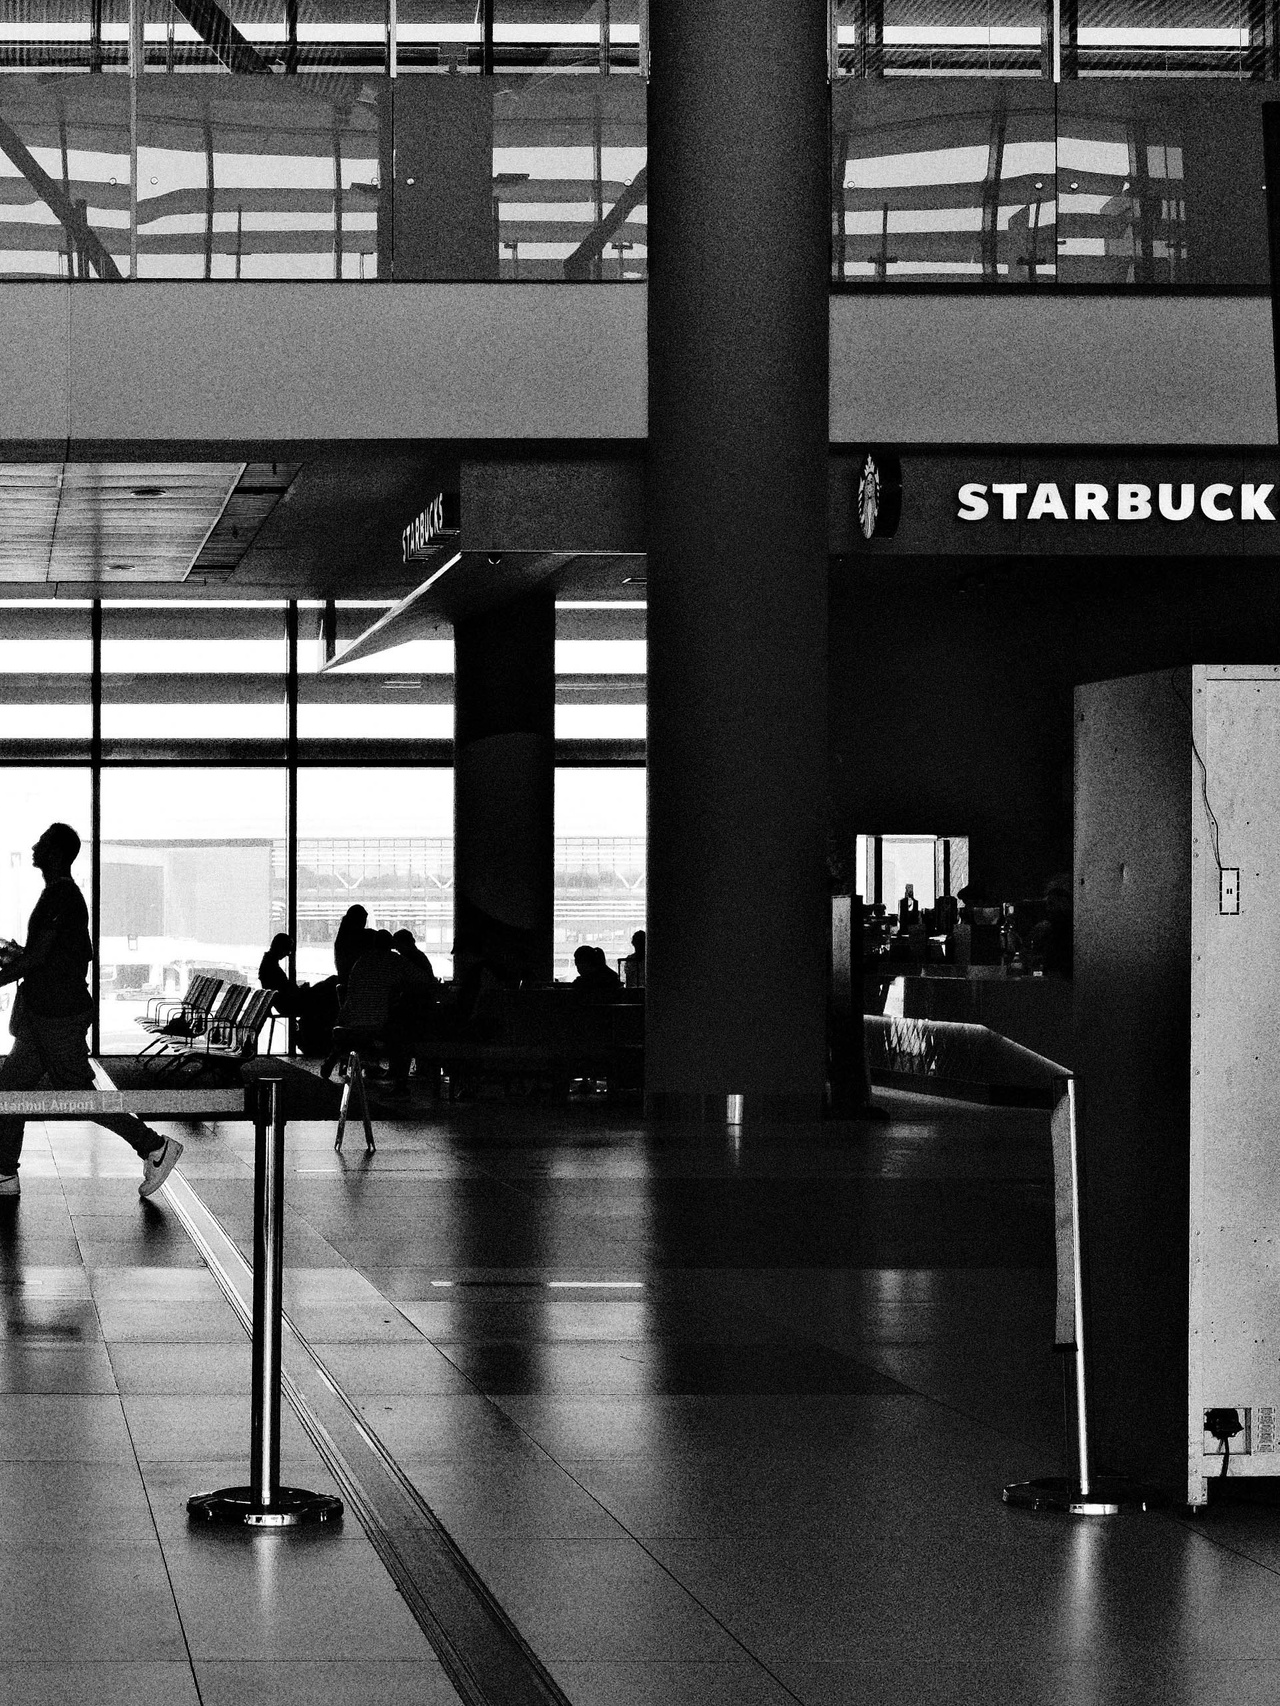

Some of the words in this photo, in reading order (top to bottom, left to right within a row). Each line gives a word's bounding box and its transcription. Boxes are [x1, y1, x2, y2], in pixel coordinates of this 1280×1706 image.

[957, 483, 1277, 522] STARBUCK
[402, 492, 443, 563] STARBUCKS
[50, 1099, 95, 1112] Airport
